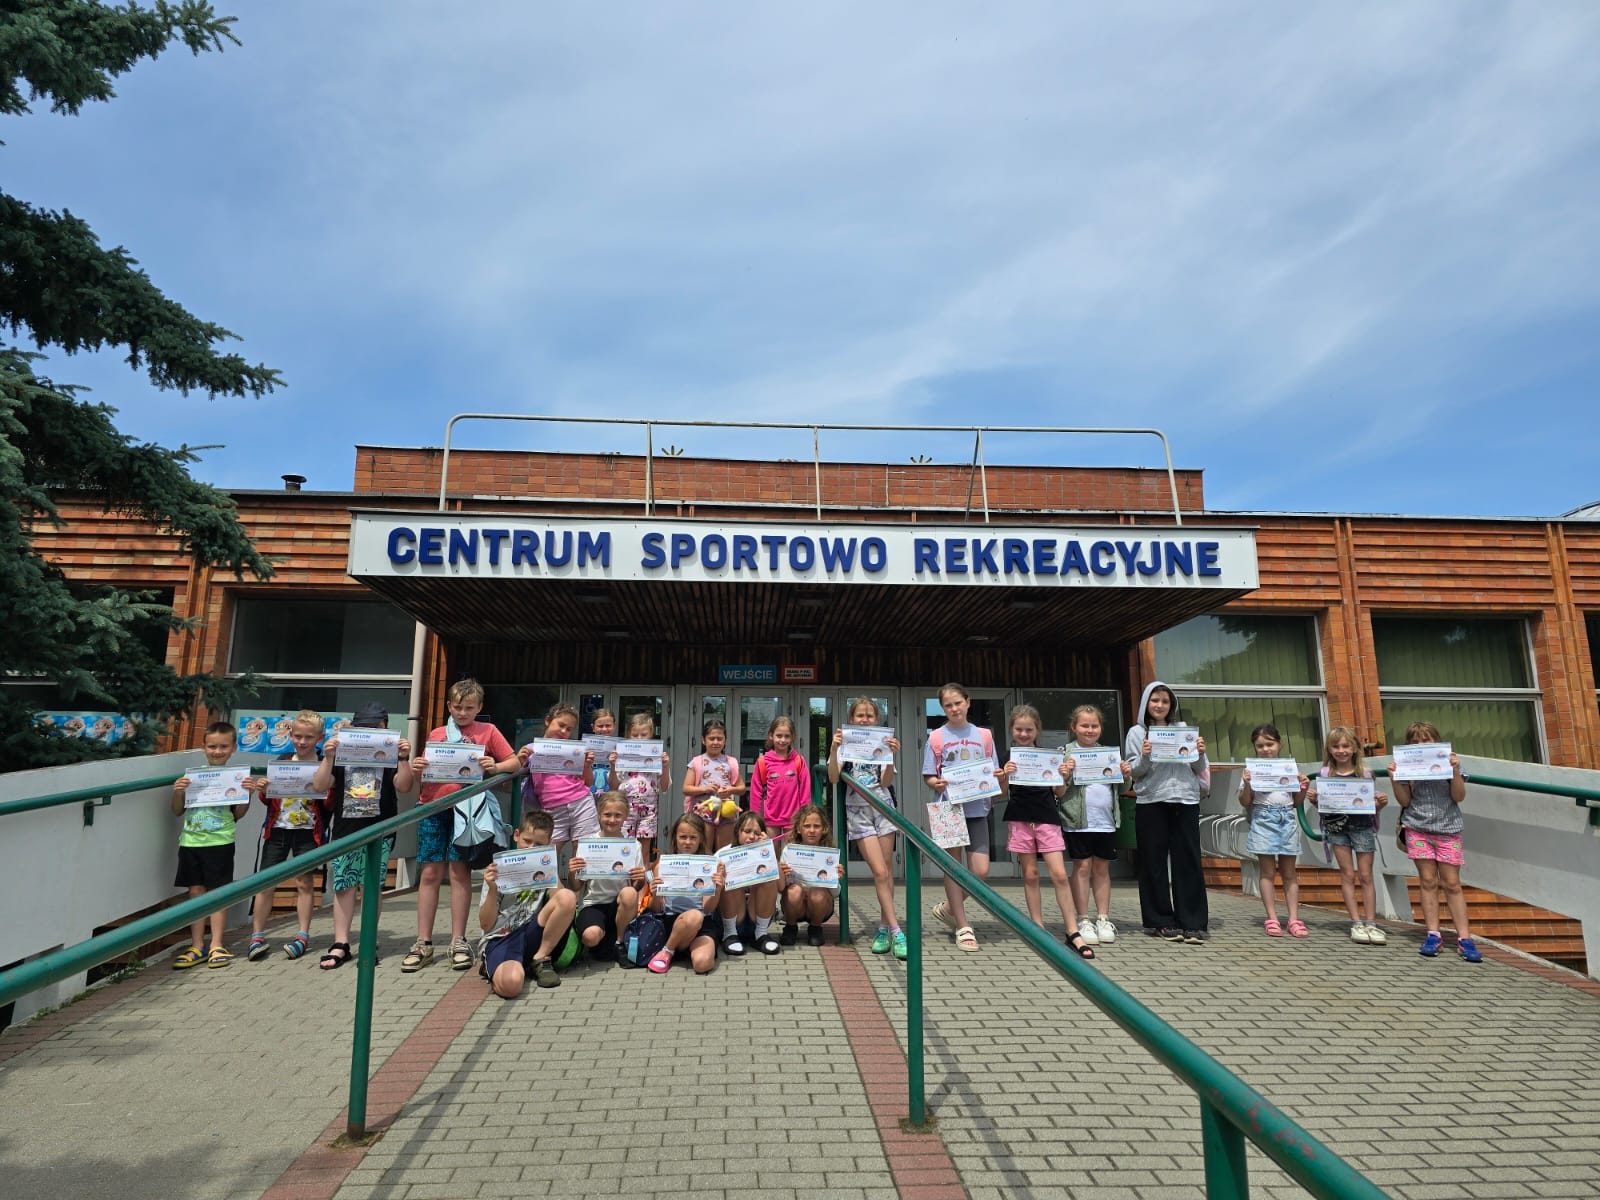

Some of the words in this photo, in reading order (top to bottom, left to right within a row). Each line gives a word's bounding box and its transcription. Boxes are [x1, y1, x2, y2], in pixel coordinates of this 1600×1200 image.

[387, 527, 610, 568] CENTRUM
[641, 532, 886, 573] SPORTOWO
[915, 538, 1222, 577] REKREACYJNE
[723, 668, 773, 680] WEJŚCIE
[504, 856, 527, 864] DYPLOM
